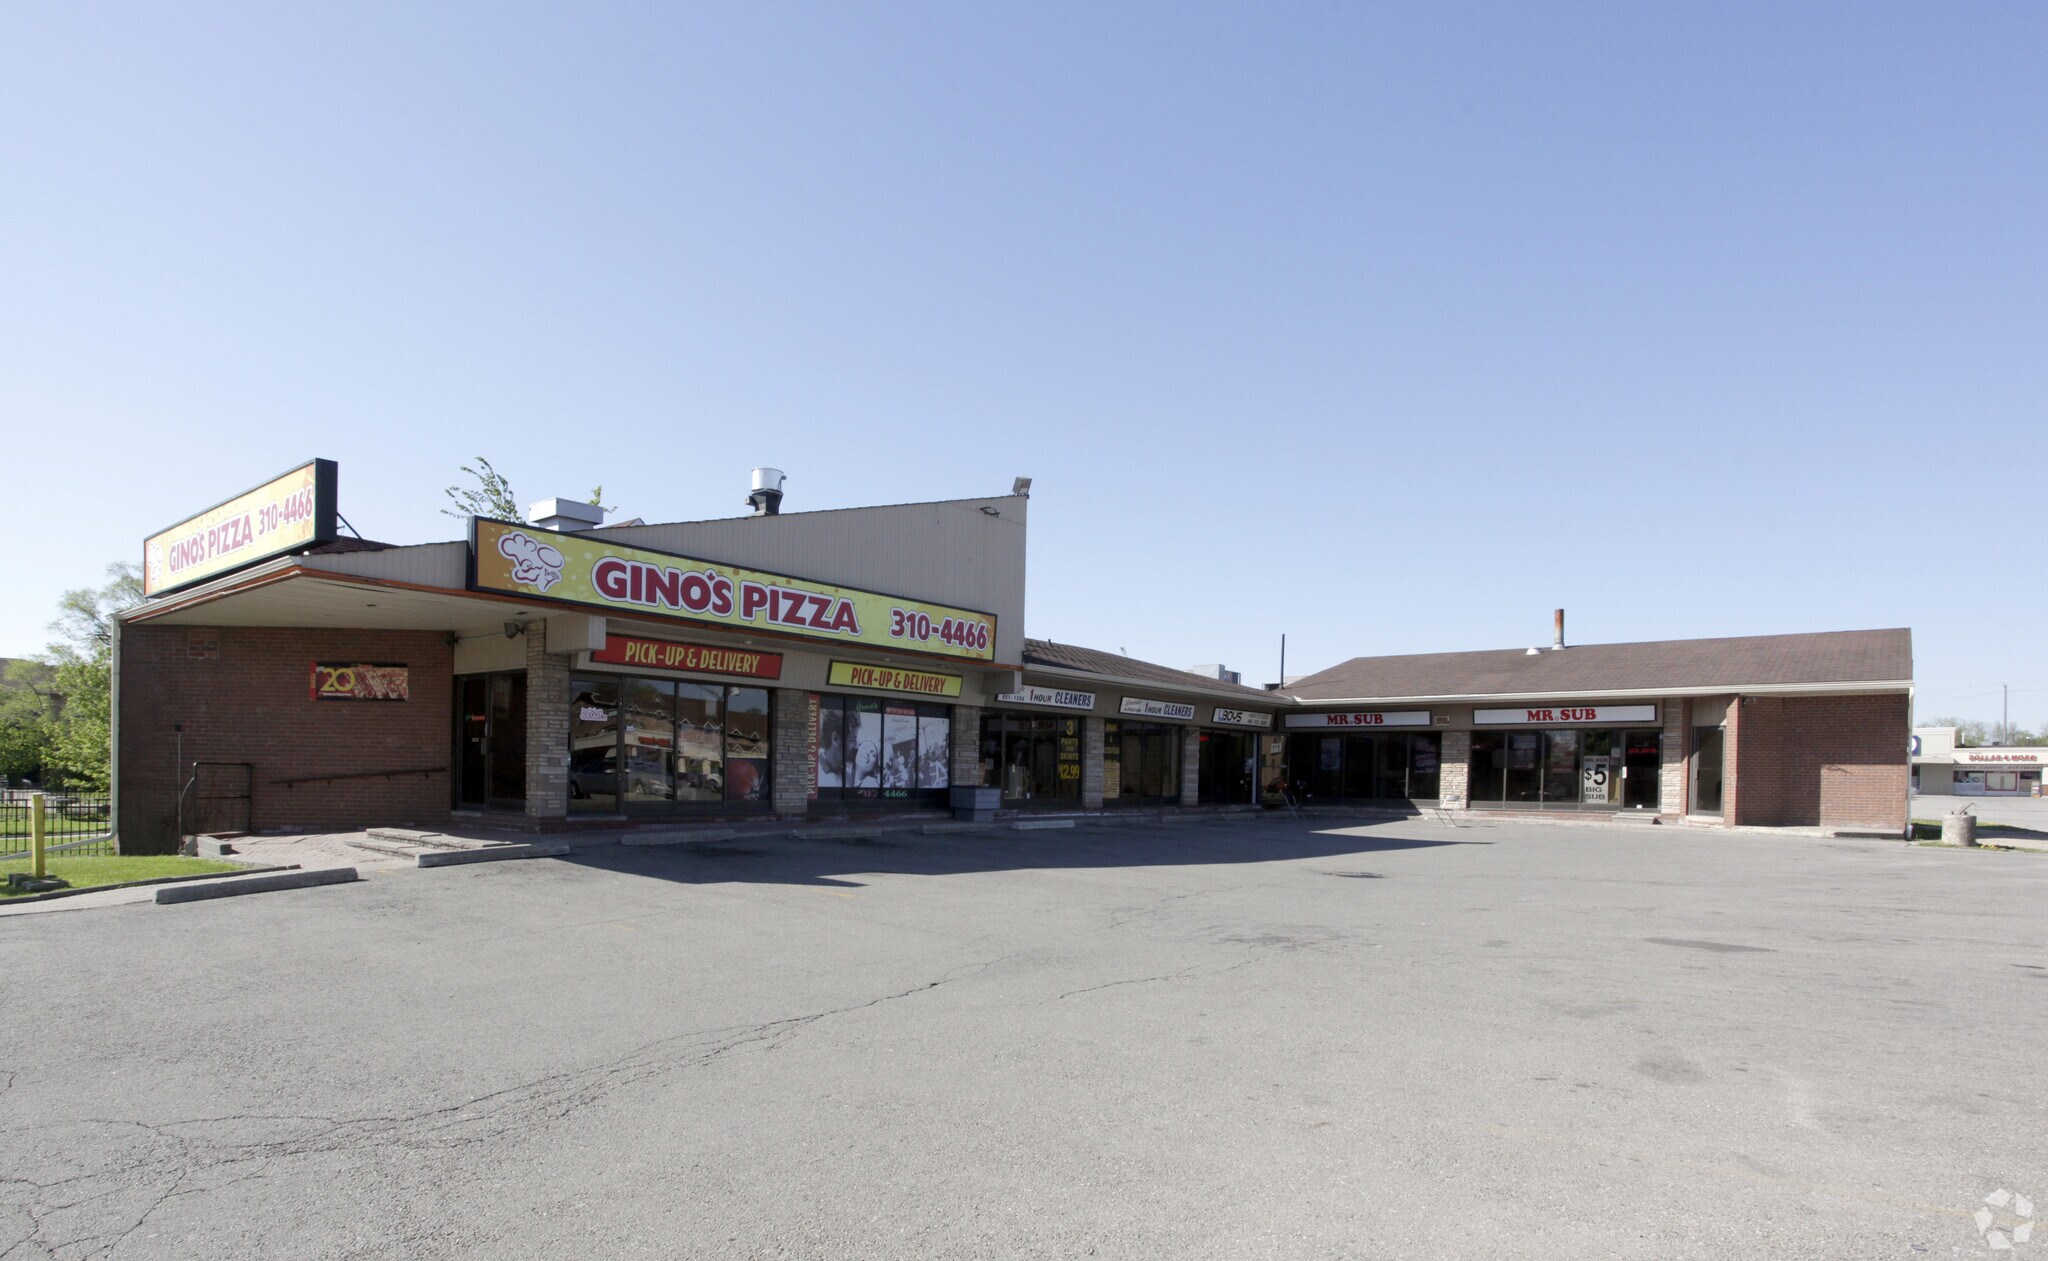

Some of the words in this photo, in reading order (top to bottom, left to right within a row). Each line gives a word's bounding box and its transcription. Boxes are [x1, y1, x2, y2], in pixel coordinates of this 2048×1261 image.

[169, 531, 206, 574] GINO'S
[208, 513, 253, 559] PIZZA
[258, 487, 313, 536] 310-4466
[594, 558, 733, 615] GINO'S
[742, 584, 860, 634] PIZZA
[892, 608, 988, 650] 310-4466
[625, 640, 684, 667] PICK-UP
[686, 649, 698, 669] &
[699, 650, 760, 674] DELIVERY
[320, 668, 356, 692] 20
[850, 666, 893, 687] PICK-UP
[894, 673, 901, 689] &
[903, 673, 947, 693] DELIVERY
[1029, 688, 1035, 701] 1
[1034, 694, 1052, 703] HOUR
[1055, 691, 1092, 707] CLEANERS
[1144, 702, 1149, 713] 1
[1148, 706, 1162, 714] HOUR
[1164, 704, 1192, 717] CLEANERS
[808, 698, 818, 744] DELIVERY
[1066, 720, 1074, 736] 3
[1968, 754, 2001, 762] DOLLAR
[807, 754, 817, 796] PICK-UP
[1058, 764, 1080, 780] $12.99
[884, 789, 908, 798] 4466
